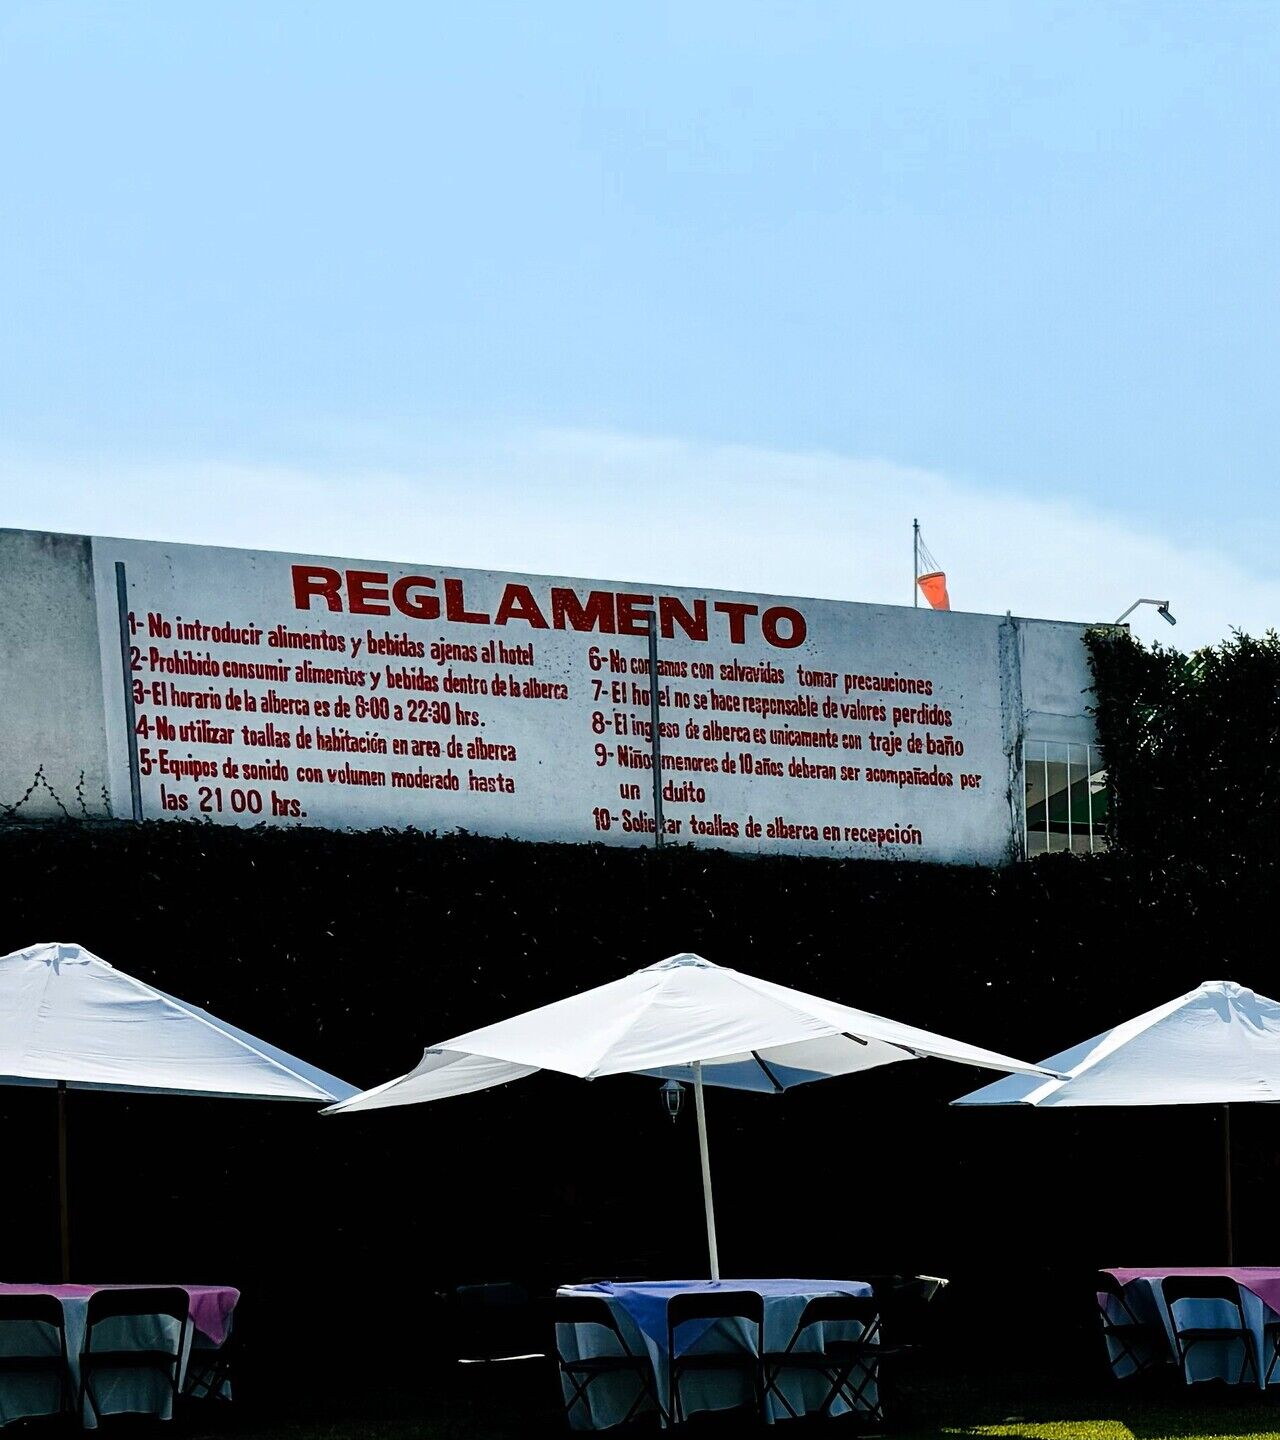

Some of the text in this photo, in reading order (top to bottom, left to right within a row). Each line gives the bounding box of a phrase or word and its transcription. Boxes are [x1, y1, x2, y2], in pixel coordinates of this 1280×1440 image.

[291, 565, 806, 648] REGLAMENTO
[176, 616, 263, 645] introducir
[268, 624, 346, 651] alimentos
[350, 637, 362, 658] y
[367, 629, 425, 658] bebidas
[431, 636, 477, 666] ajenas
[482, 640, 496, 663] al
[499, 640, 534, 666] hotel
[223, 658, 291, 684] consumir
[295, 660, 366, 687] alimentos
[370, 671, 381, 691] y
[386, 665, 439, 692] bebidas
[443, 668, 488, 695] dentro
[491, 673, 507, 697] de
[509, 674, 521, 697] la
[523, 677, 568, 700] alberca
[630, 657, 688, 678] conamos
[691, 662, 714, 680] con
[720, 658, 784, 684] salvavidas
[797, 664, 838, 688] tomar
[845, 671, 933, 697] precauciones
[171, 683, 221, 710] horario
[225, 688, 241, 711] de
[244, 689, 256, 713] la
[261, 690, 309, 716] alberca
[314, 701, 330, 717] es
[334, 695, 350, 719] de
[394, 704, 403, 721] a
[407, 699, 450, 725] 22:30
[455, 702, 486, 727] hrs.
[632, 682, 669, 708] hoel
[674, 691, 690, 709] no
[693, 693, 708, 710] se
[710, 688, 740, 713] hace
[742, 694, 818, 720] responsable
[822, 696, 838, 719] de
[841, 699, 886, 722] valores
[893, 703, 952, 728] perdidos
[179, 719, 234, 745] utilizar
[241, 722, 291, 749] toallas
[296, 725, 312, 749] de
[316, 727, 387, 754] habitación
[392, 737, 408, 755] en
[412, 740, 440, 758] area
[447, 734, 463, 758] de
[467, 736, 516, 761] alberca
[631, 713, 679, 743] ingeso
[685, 718, 700, 740] de
[703, 720, 750, 743] alberca
[753, 728, 766, 745] es
[770, 723, 838, 749] unicamente
[869, 731, 902, 757] traje
[907, 732, 922, 754] de
[926, 732, 964, 756] baño
[222, 757, 239, 779] de
[242, 758, 288, 782] sonido
[296, 767, 324, 783] con
[327, 761, 386, 787] volumen
[391, 765, 459, 791] moderado
[468, 769, 515, 794] hasta
[617, 745, 655, 769] Niño
[661, 754, 719, 773] menores
[721, 752, 736, 774] de
[739, 753, 752, 775] 10
[755, 757, 783, 778] años
[788, 756, 836, 781] deberan
[841, 765, 860, 781] ser
[865, 765, 953, 789] acompañados
[960, 773, 982, 790] por
[160, 783, 188, 811] las
[271, 790, 307, 818] hrs.
[620, 783, 640, 801] un
[621, 809, 682, 833] Solictar
[690, 814, 739, 838] toallas
[745, 816, 762, 839] de
[767, 817, 818, 840] alberca
[823, 824, 840, 841] en
[844, 823, 922, 848] recepción
